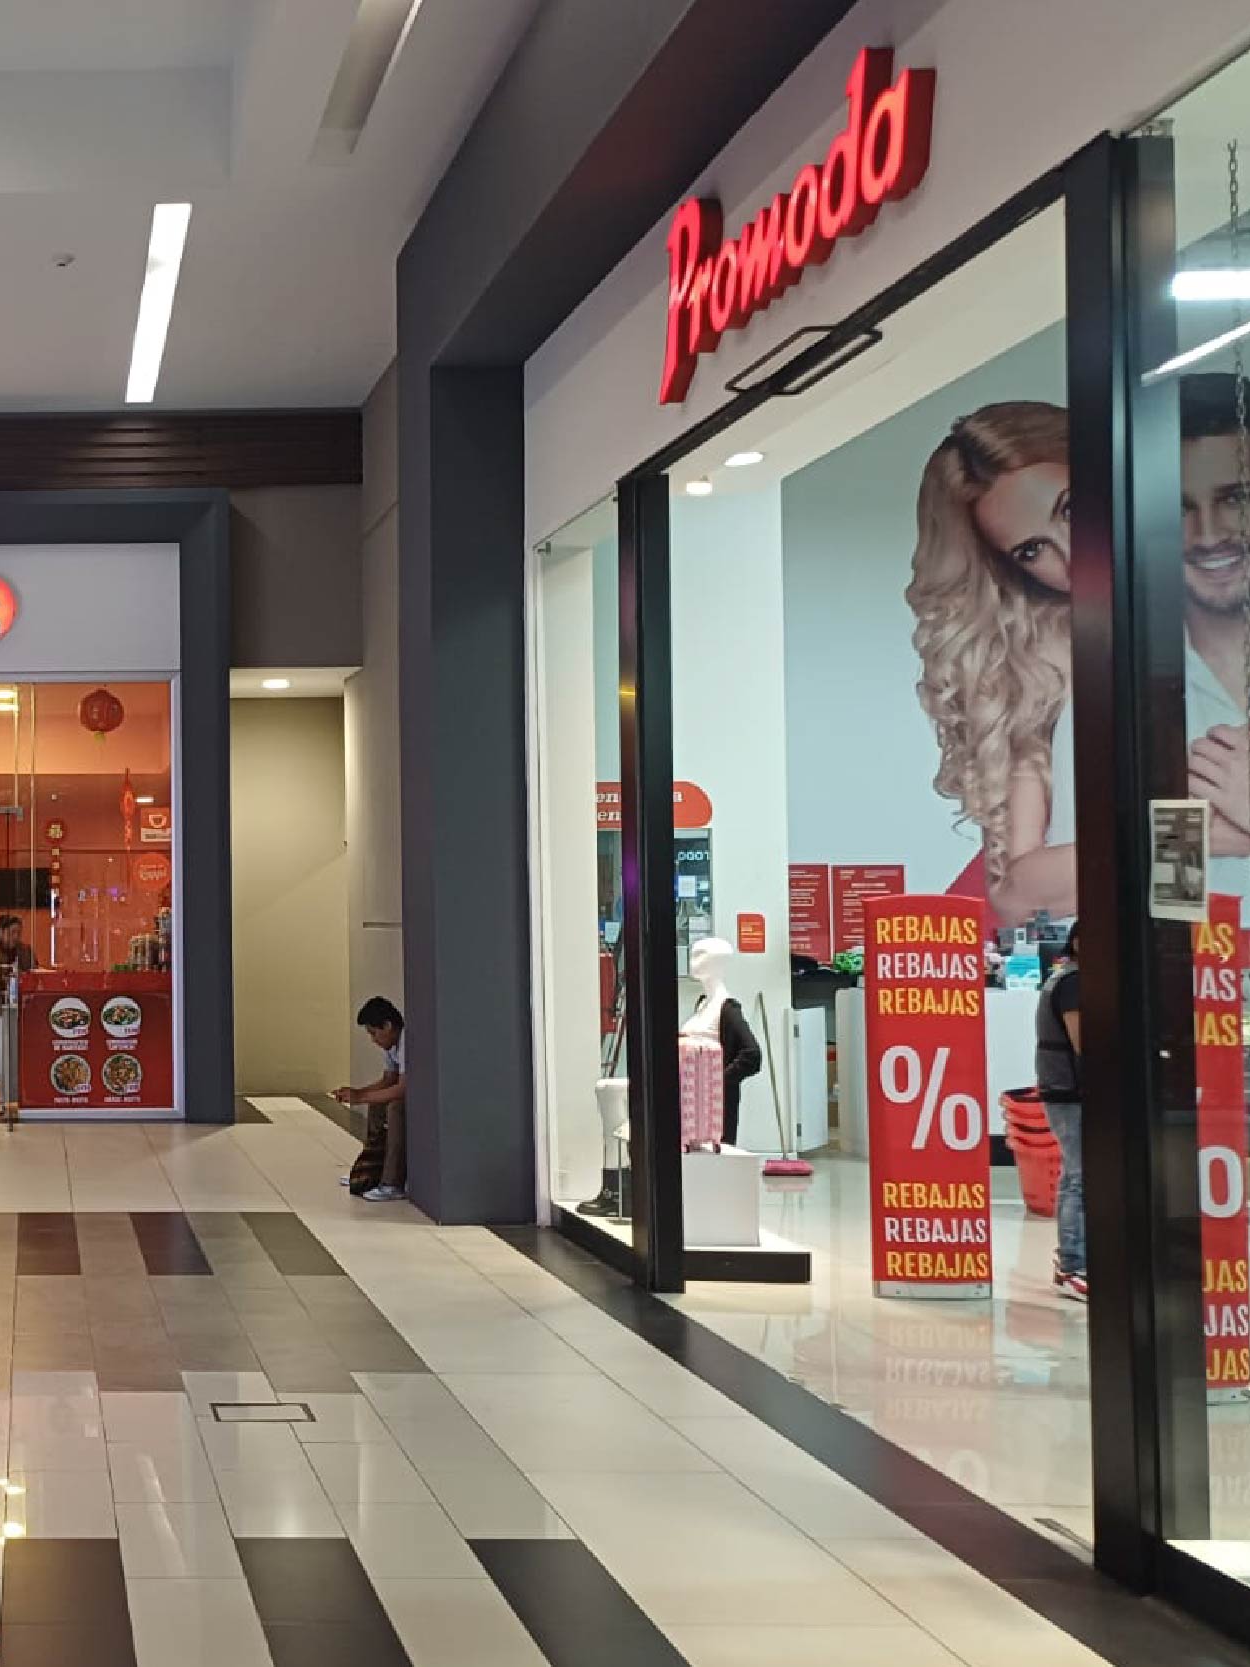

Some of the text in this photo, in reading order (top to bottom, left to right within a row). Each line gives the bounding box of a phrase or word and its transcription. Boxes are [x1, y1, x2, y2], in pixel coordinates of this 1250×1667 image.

[659, 47, 936, 405] Promoda
[876, 915, 978, 945] REBAJAS
[877, 953, 978, 980] REBAJAS
[878, 988, 980, 1017] REBAJAS
[879, 1044, 982, 1152] %
[883, 1182, 986, 1209] REBAJAS
[884, 1217, 988, 1243] REBAJAS
[886, 1251, 990, 1278] REBAJAS
